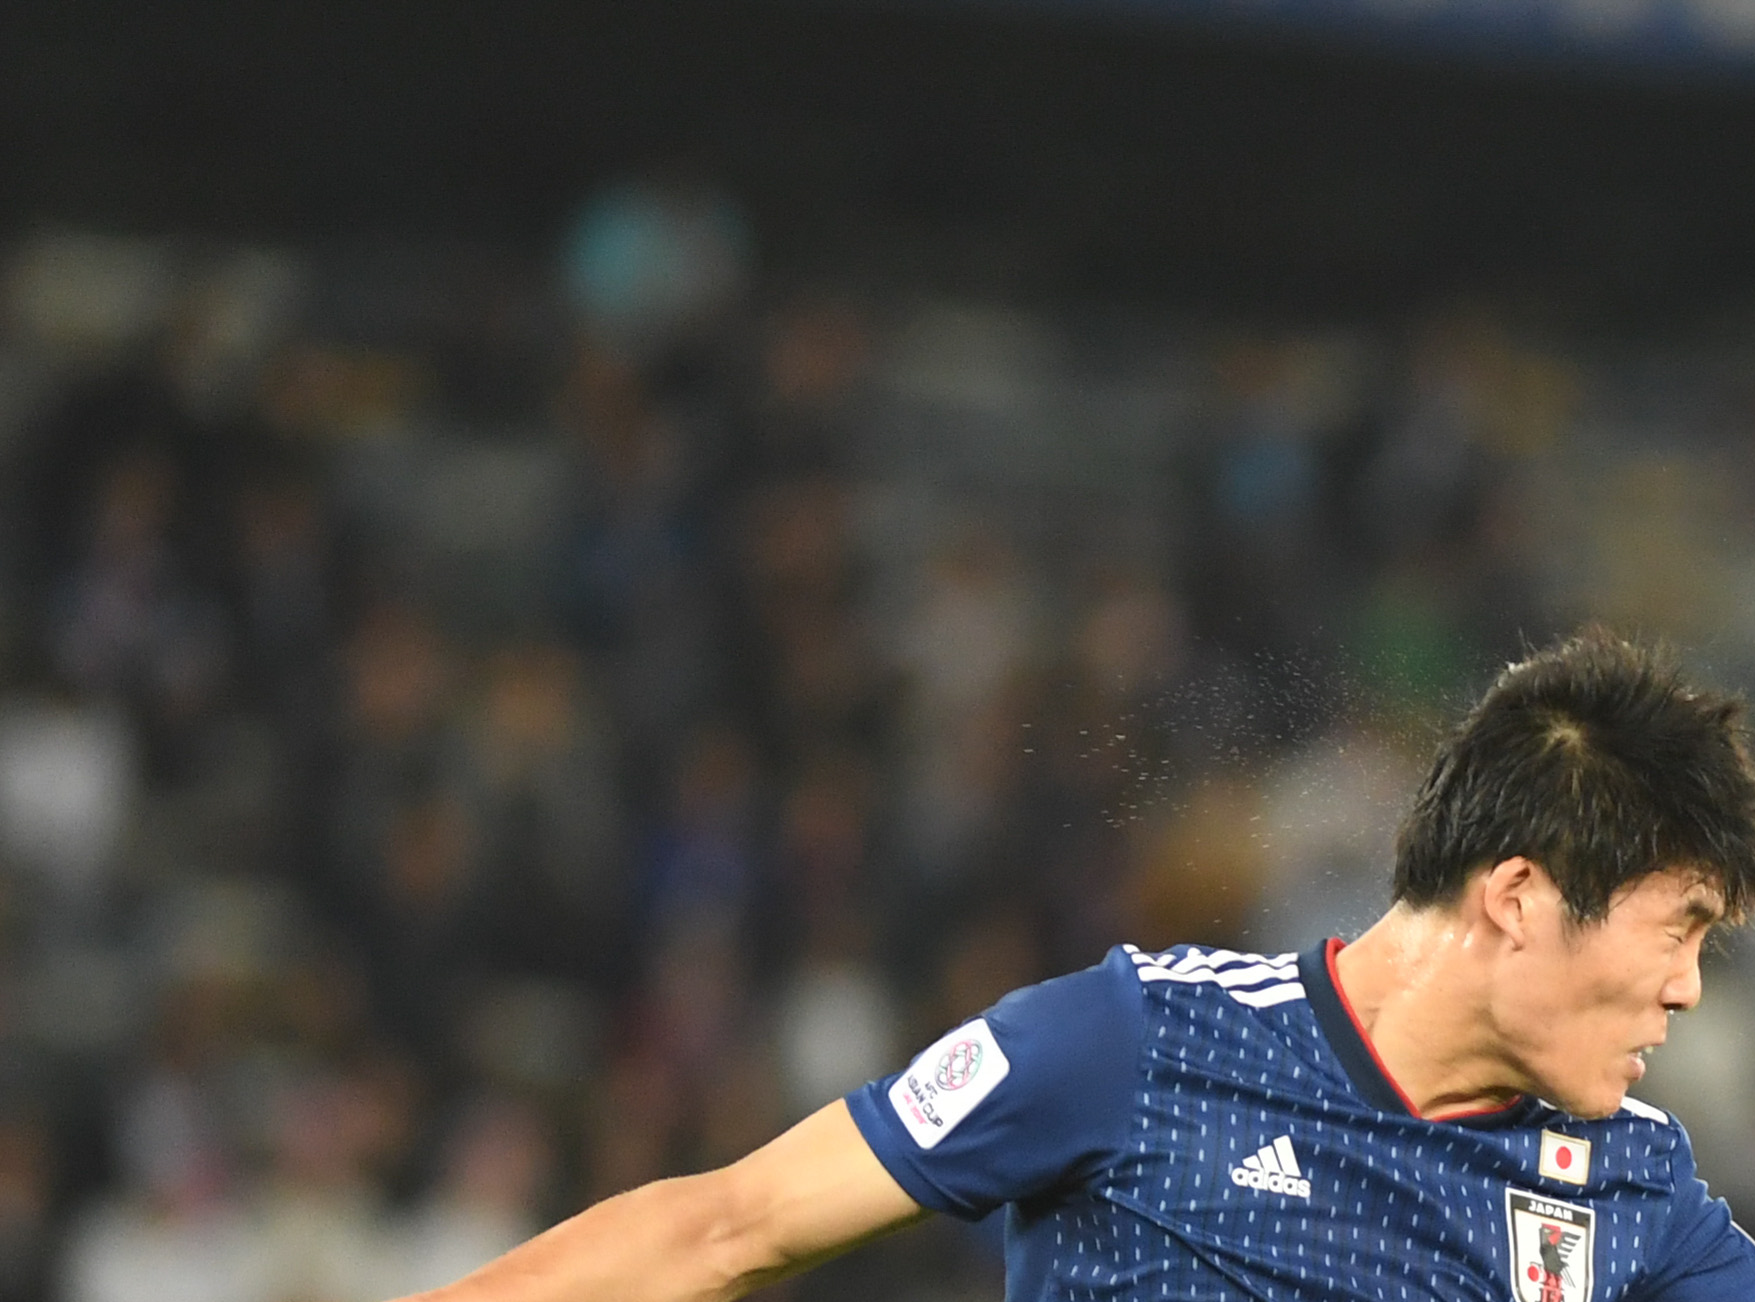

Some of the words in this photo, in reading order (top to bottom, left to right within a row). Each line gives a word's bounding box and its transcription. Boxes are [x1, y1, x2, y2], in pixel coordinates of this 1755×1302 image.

[922, 1102, 944, 1127] CUP
[1231, 1167, 1311, 1198] adidas
[1528, 1200, 1573, 1222] JAPAN
